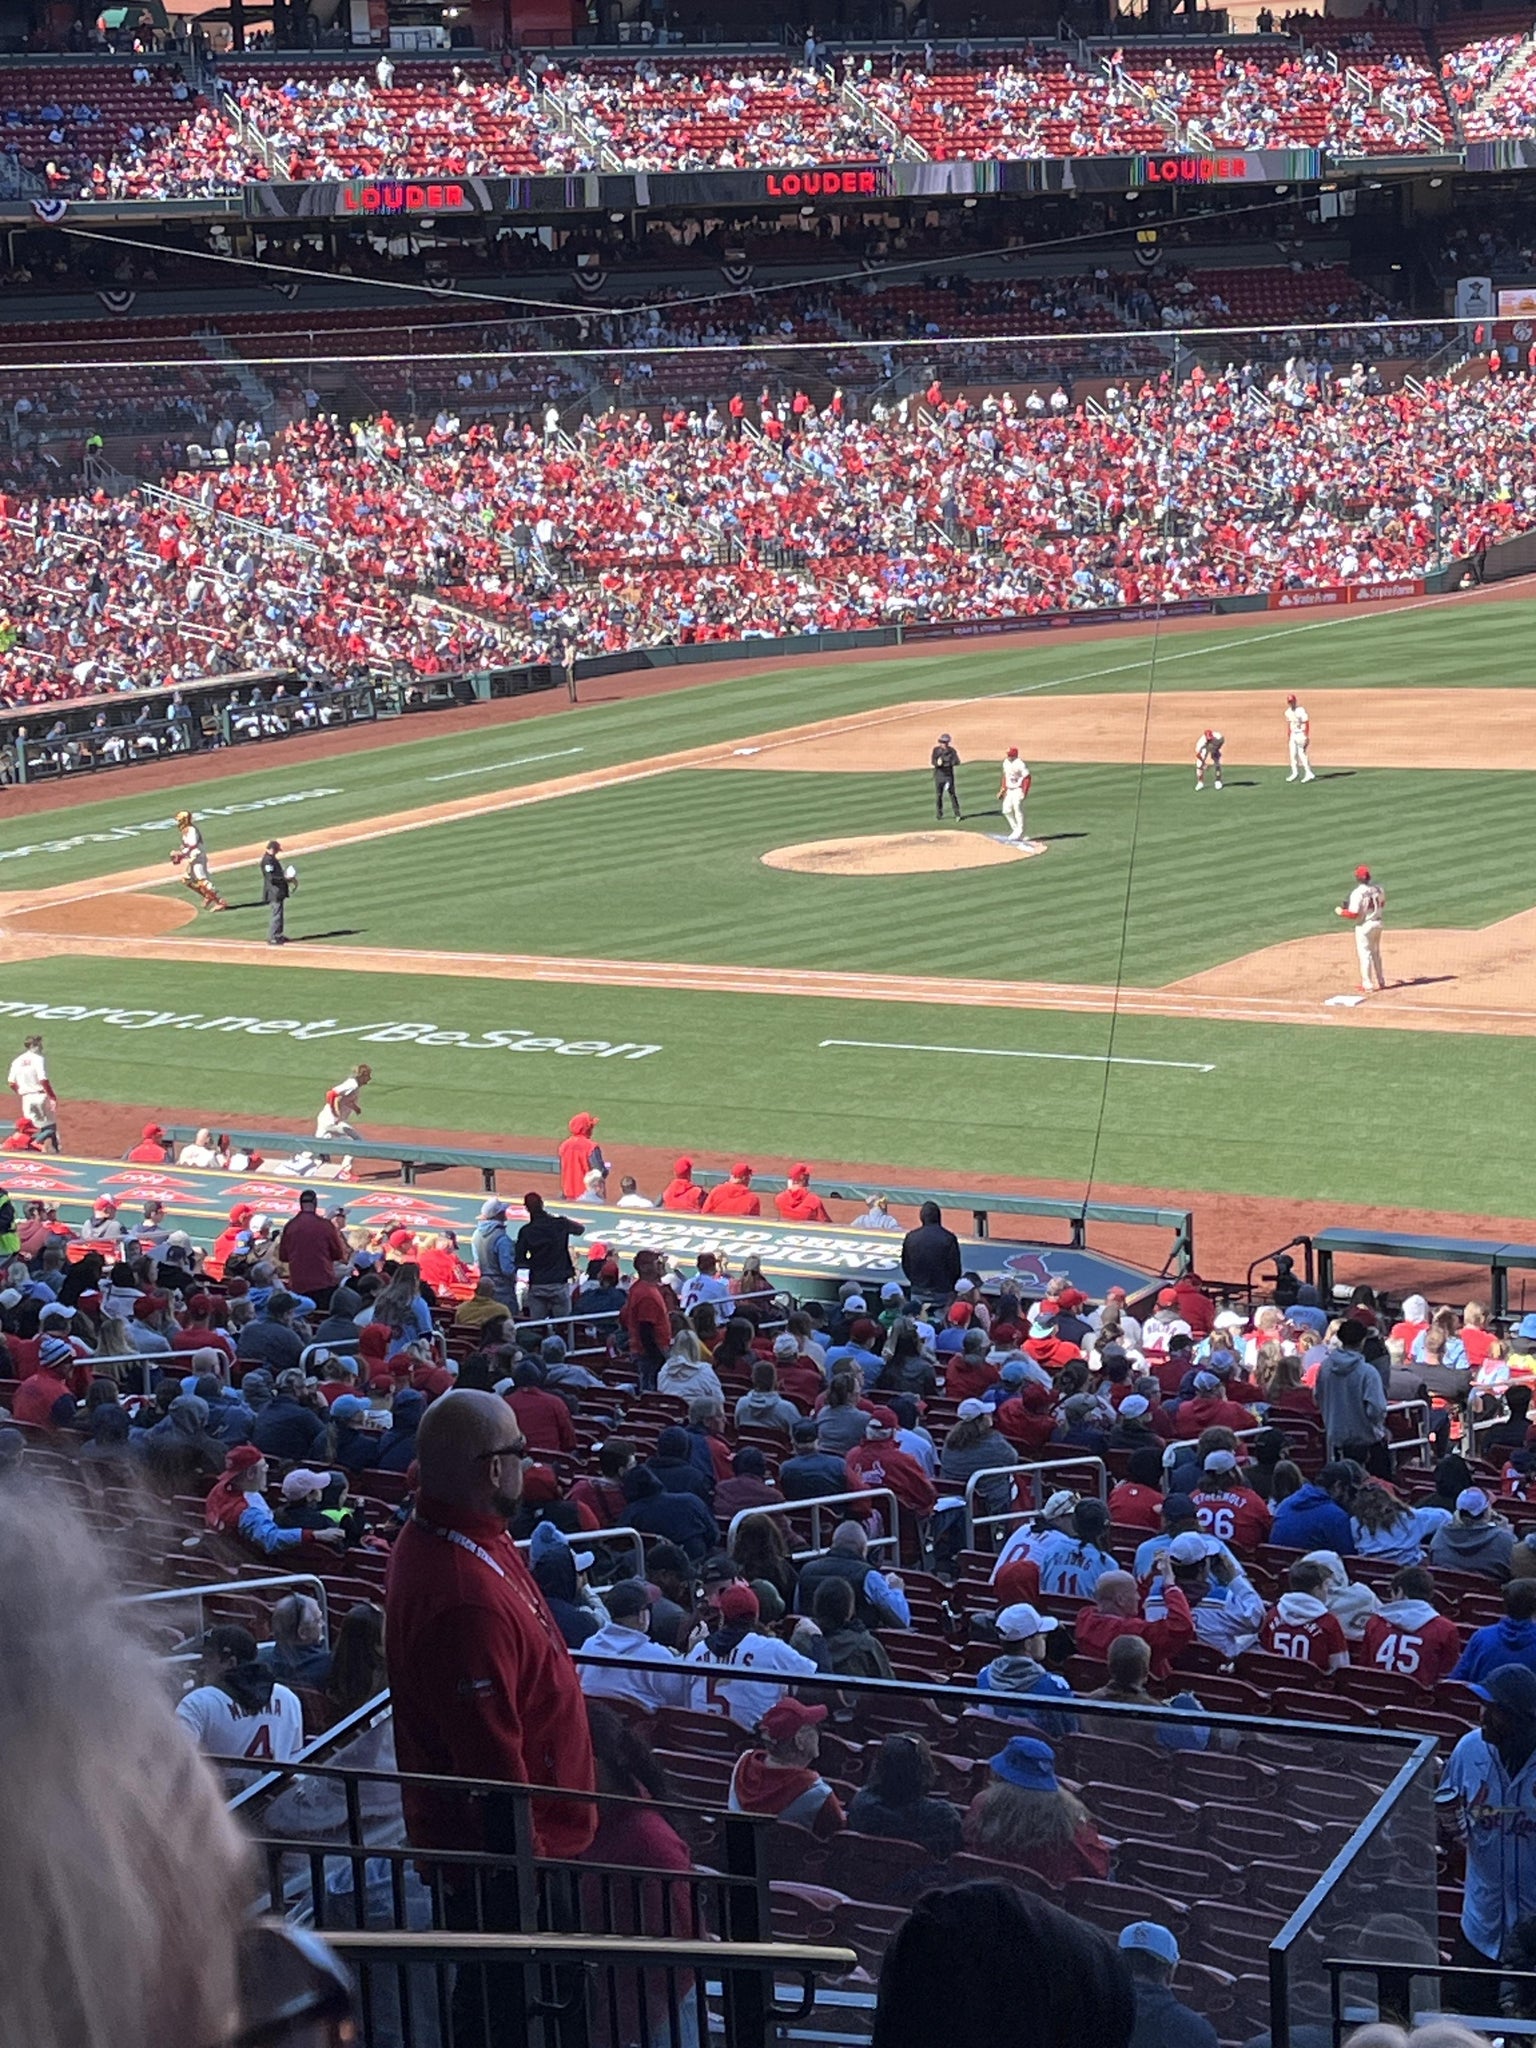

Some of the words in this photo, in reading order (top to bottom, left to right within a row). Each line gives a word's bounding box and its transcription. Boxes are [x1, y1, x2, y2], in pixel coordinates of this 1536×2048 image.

[766, 171, 876, 197] LOUDER
[1147, 157, 1248, 182] LOUDER
[344, 185, 464, 210] LOUDER
[583, 1230, 902, 1272] CHAMPIONS
[615, 1219, 772, 1243] WORLD
[774, 1235, 903, 1258] SERIE
[1196, 1507, 1235, 1540] 26
[1056, 1570, 1079, 1596] 11
[1273, 1632, 1311, 1661] 50
[1375, 1634, 1424, 1675] 45
[243, 1724, 275, 1760] 4
